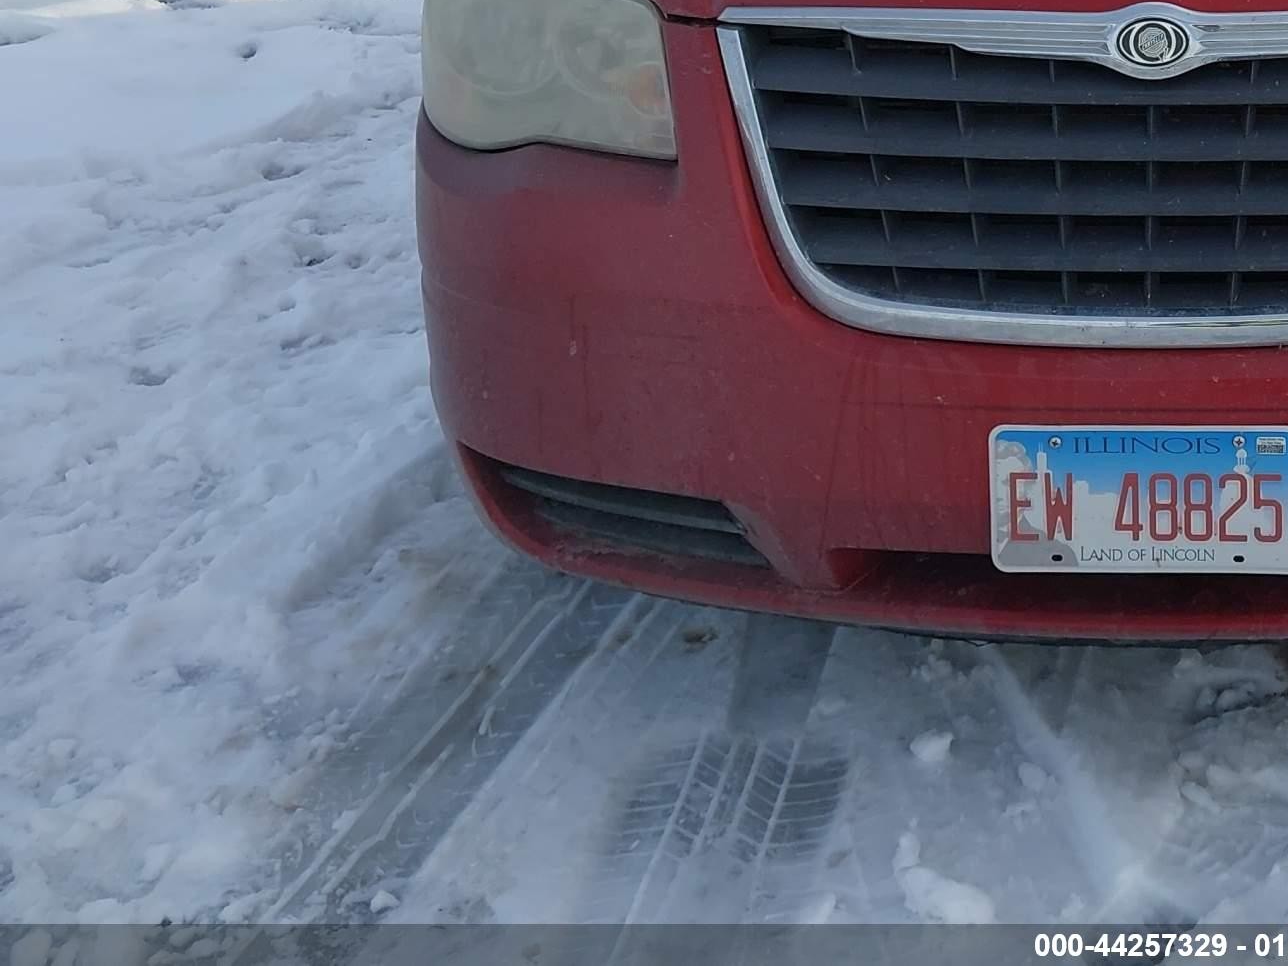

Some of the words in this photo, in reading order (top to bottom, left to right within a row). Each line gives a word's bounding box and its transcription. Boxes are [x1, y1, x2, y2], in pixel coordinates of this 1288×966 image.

[1073, 436, 1222, 454] ILLINOIS
[1008, 472, 1073, 542] EW
[1114, 472, 1282, 542] 48825
